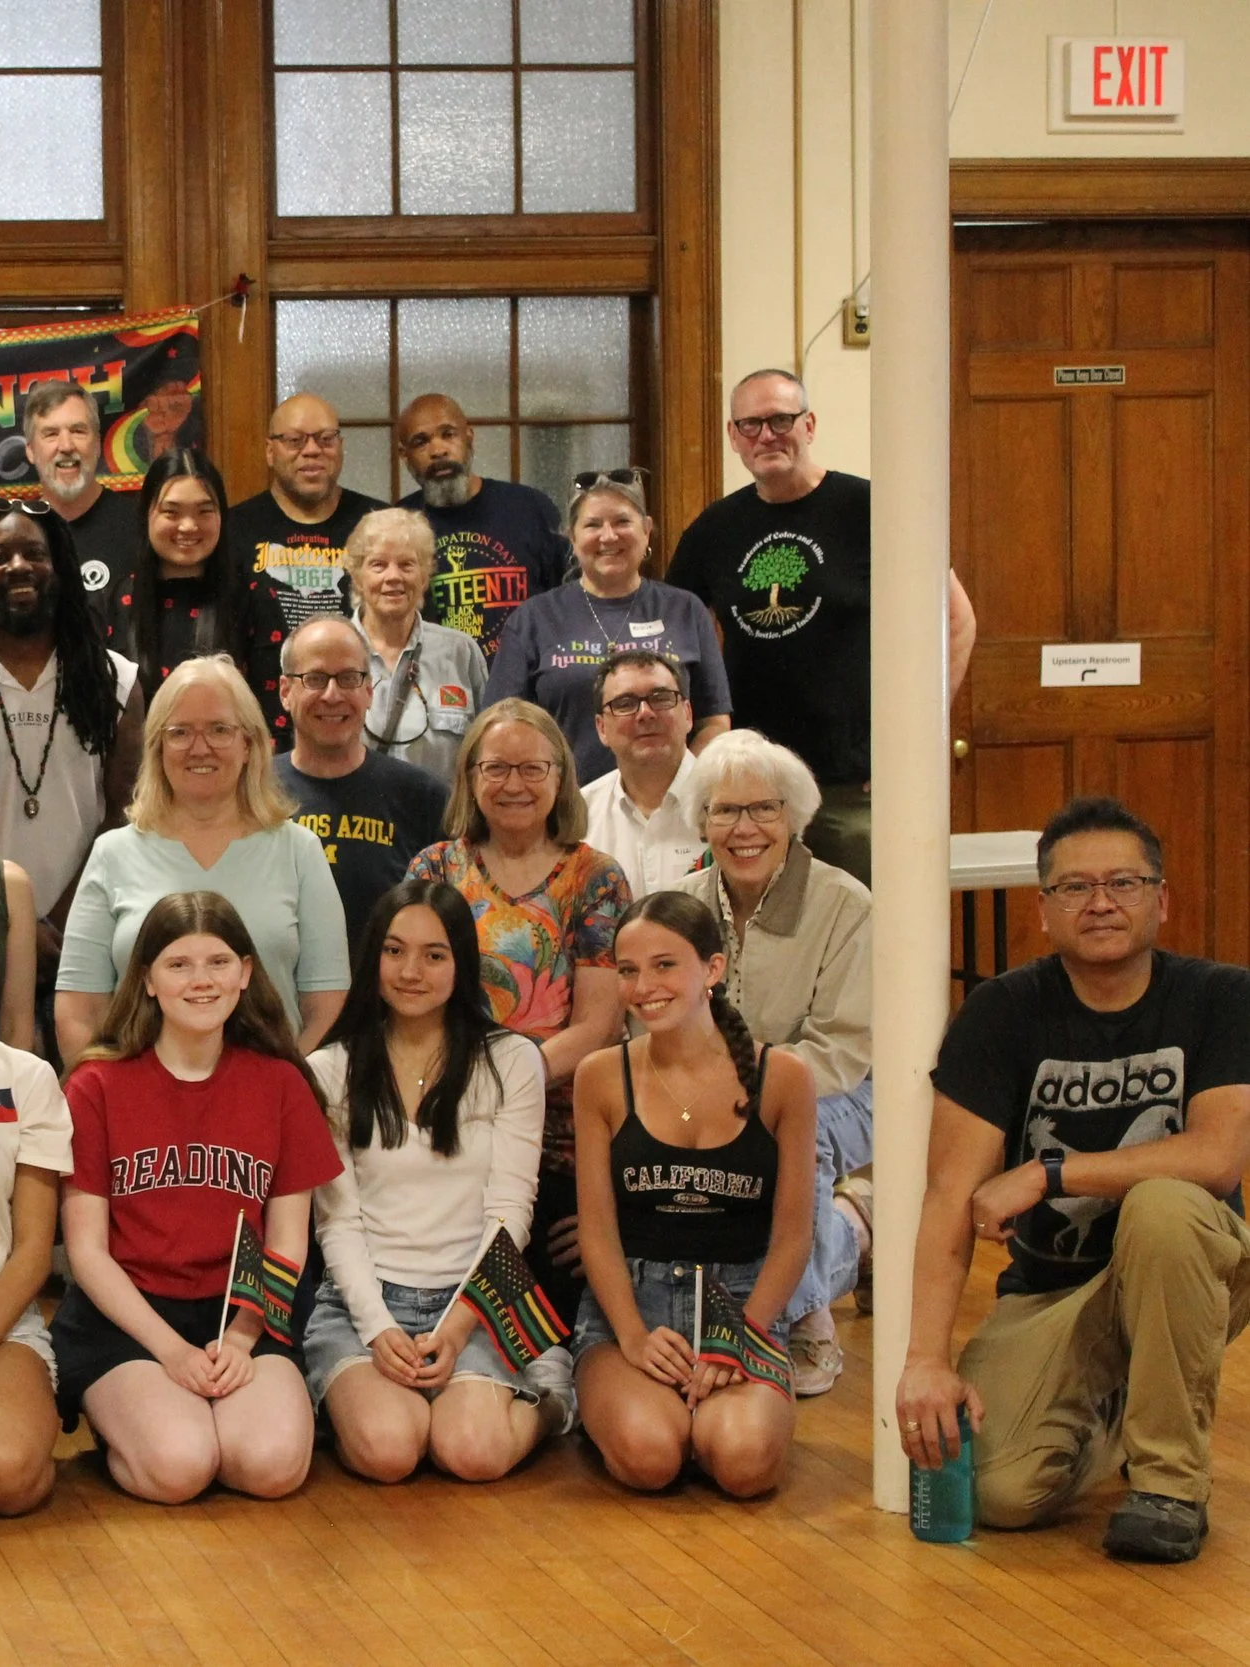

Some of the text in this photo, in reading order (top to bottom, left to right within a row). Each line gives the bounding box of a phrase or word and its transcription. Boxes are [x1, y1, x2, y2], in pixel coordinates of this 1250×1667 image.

[1093, 46, 1169, 107] EXIT
[772, 530, 797, 540] Color
[286, 567, 333, 588] 1865
[571, 640, 602, 655] big
[641, 637, 662, 653] of
[1052, 656, 1130, 667] Upstairs Restroom
[8, 711, 50, 724] GUESS
[336, 814, 395, 847] AZUL!
[1037, 1059, 1177, 1107] adobo
[110, 1143, 274, 1204] READING
[623, 1165, 763, 1199] CALIFORNIA
[470, 1270, 531, 1360] UNETEENTH
